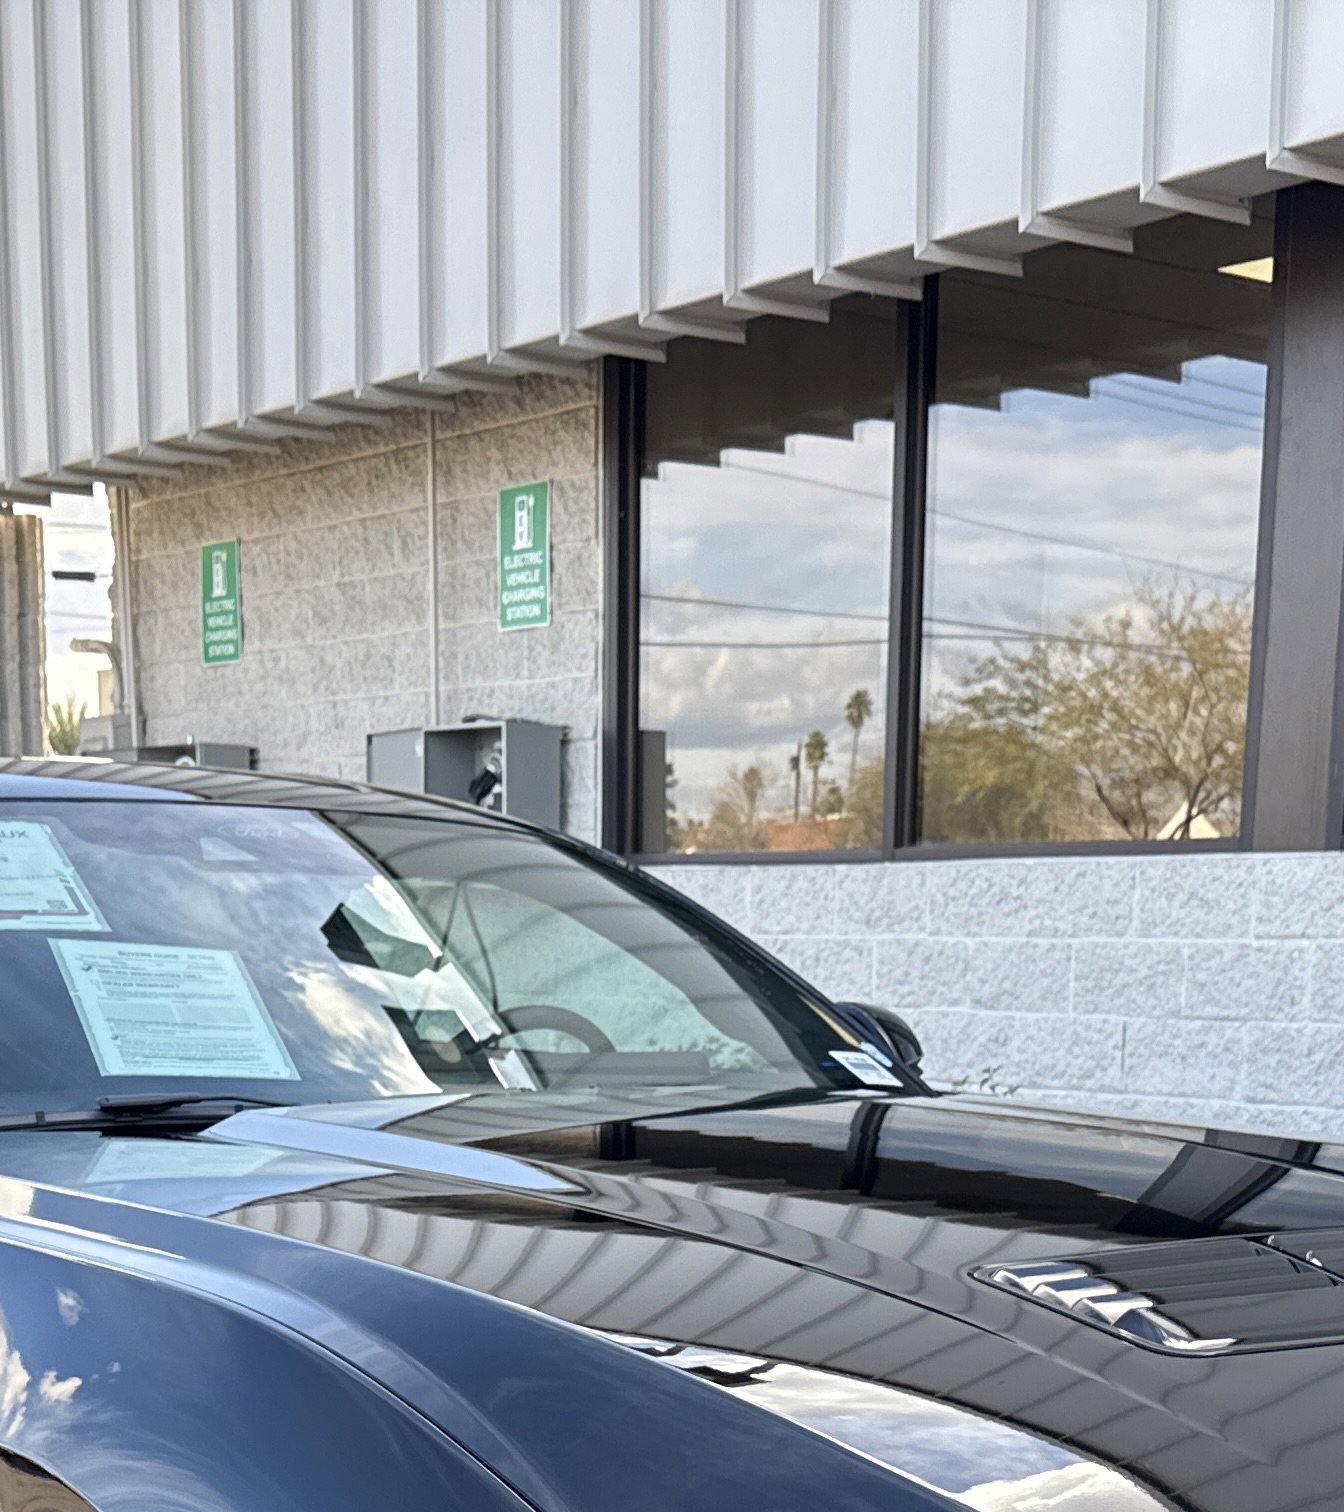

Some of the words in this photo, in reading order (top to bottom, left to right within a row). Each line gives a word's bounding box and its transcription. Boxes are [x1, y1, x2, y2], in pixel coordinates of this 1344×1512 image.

[503, 551, 543, 570] ELECTRIC
[506, 569, 540, 587] VEHICLE
[502, 586, 545, 605] CHARGING
[506, 603, 541, 621] STATION
